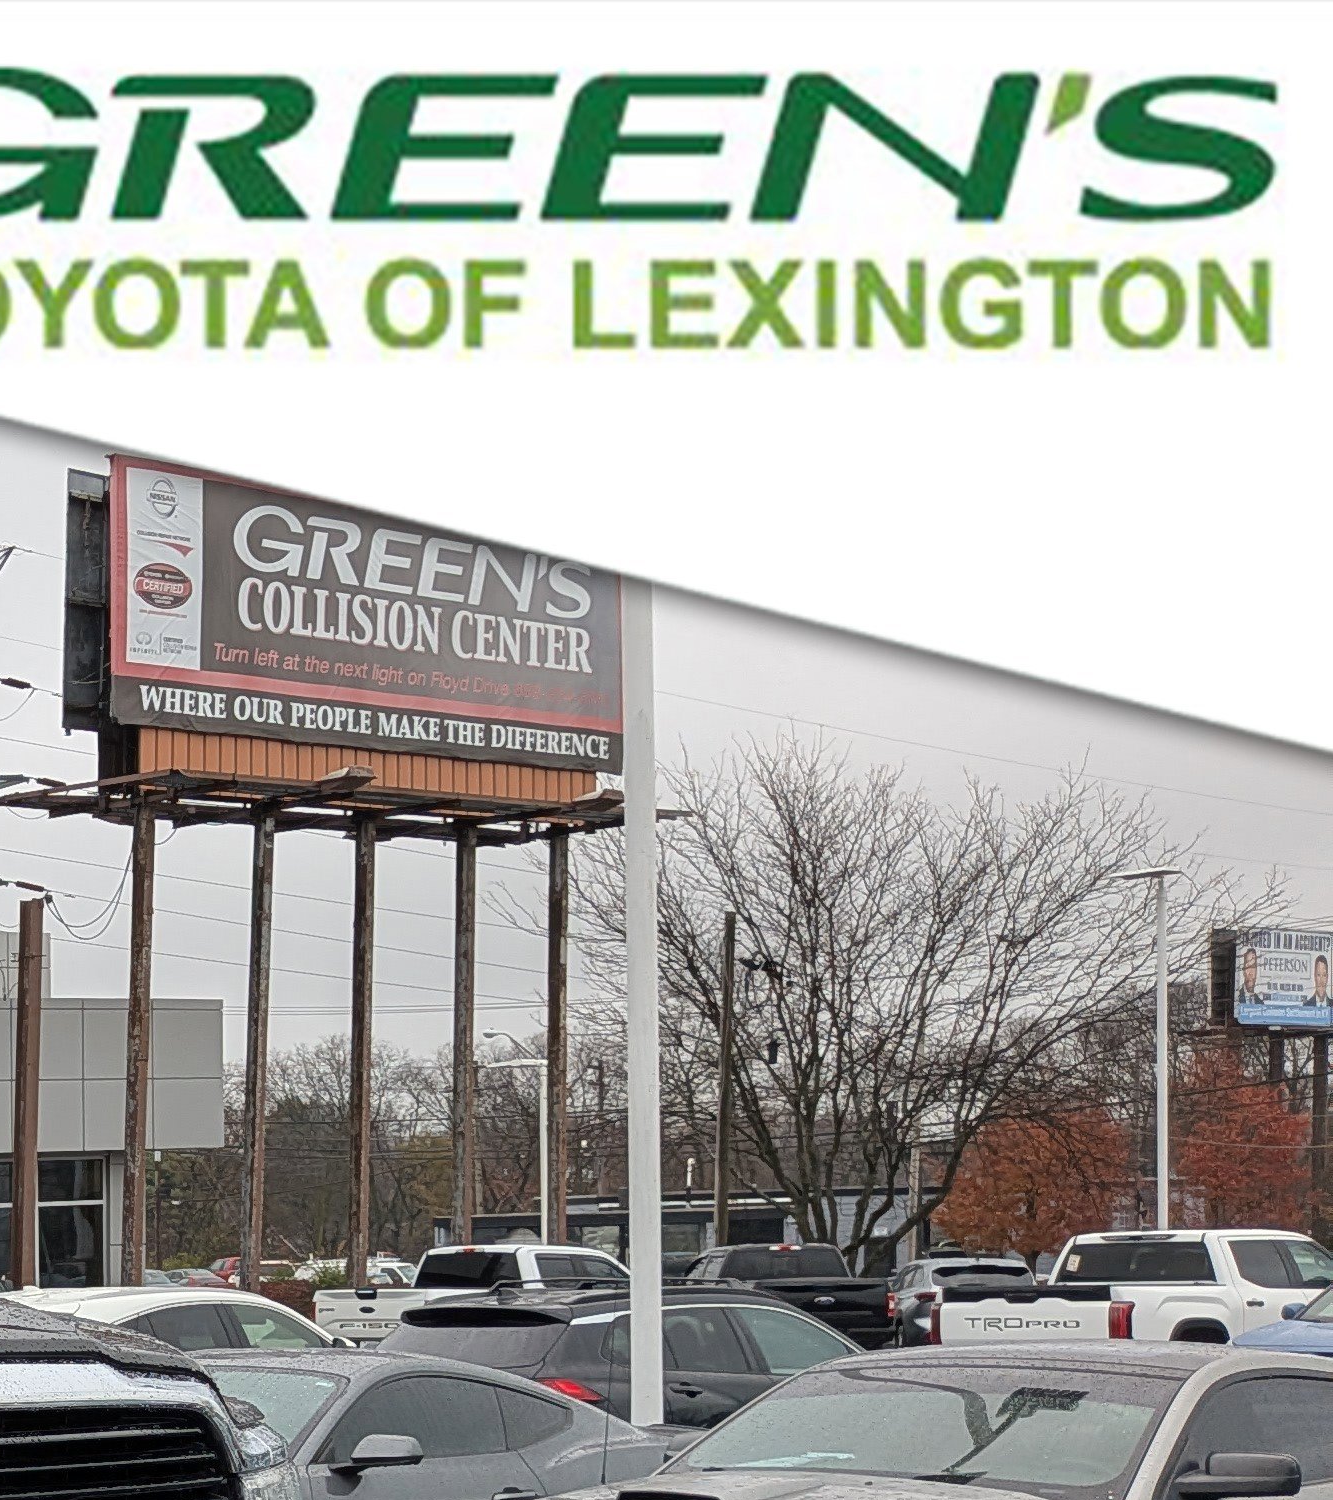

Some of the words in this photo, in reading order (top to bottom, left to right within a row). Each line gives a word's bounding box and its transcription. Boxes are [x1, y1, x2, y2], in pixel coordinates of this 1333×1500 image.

[149, 493, 176, 503] NISSAN
[143, 579, 184, 595] CERTIFIED
[233, 505, 592, 619] GREEN'S
[237, 577, 442, 655] COLLISION
[452, 610, 593, 674] CENTER
[214, 642, 249, 664] Turn
[254, 647, 279, 668] left
[283, 654, 300, 671] at
[304, 655, 330, 674] the
[334, 662, 368, 679] next
[372, 664, 403, 686] light
[408, 671, 426, 686] on
[430, 671, 469, 694] Floyd
[139, 684, 227, 719] WHERE
[233, 695, 285, 725] OUR
[290, 701, 372, 735] PEOPLE
[377, 712, 441, 742] MAKE
[444, 719, 486, 747] THE
[490, 724, 610, 760] DIFFERENCE
[1263, 957, 1308, 973] PETERSON
